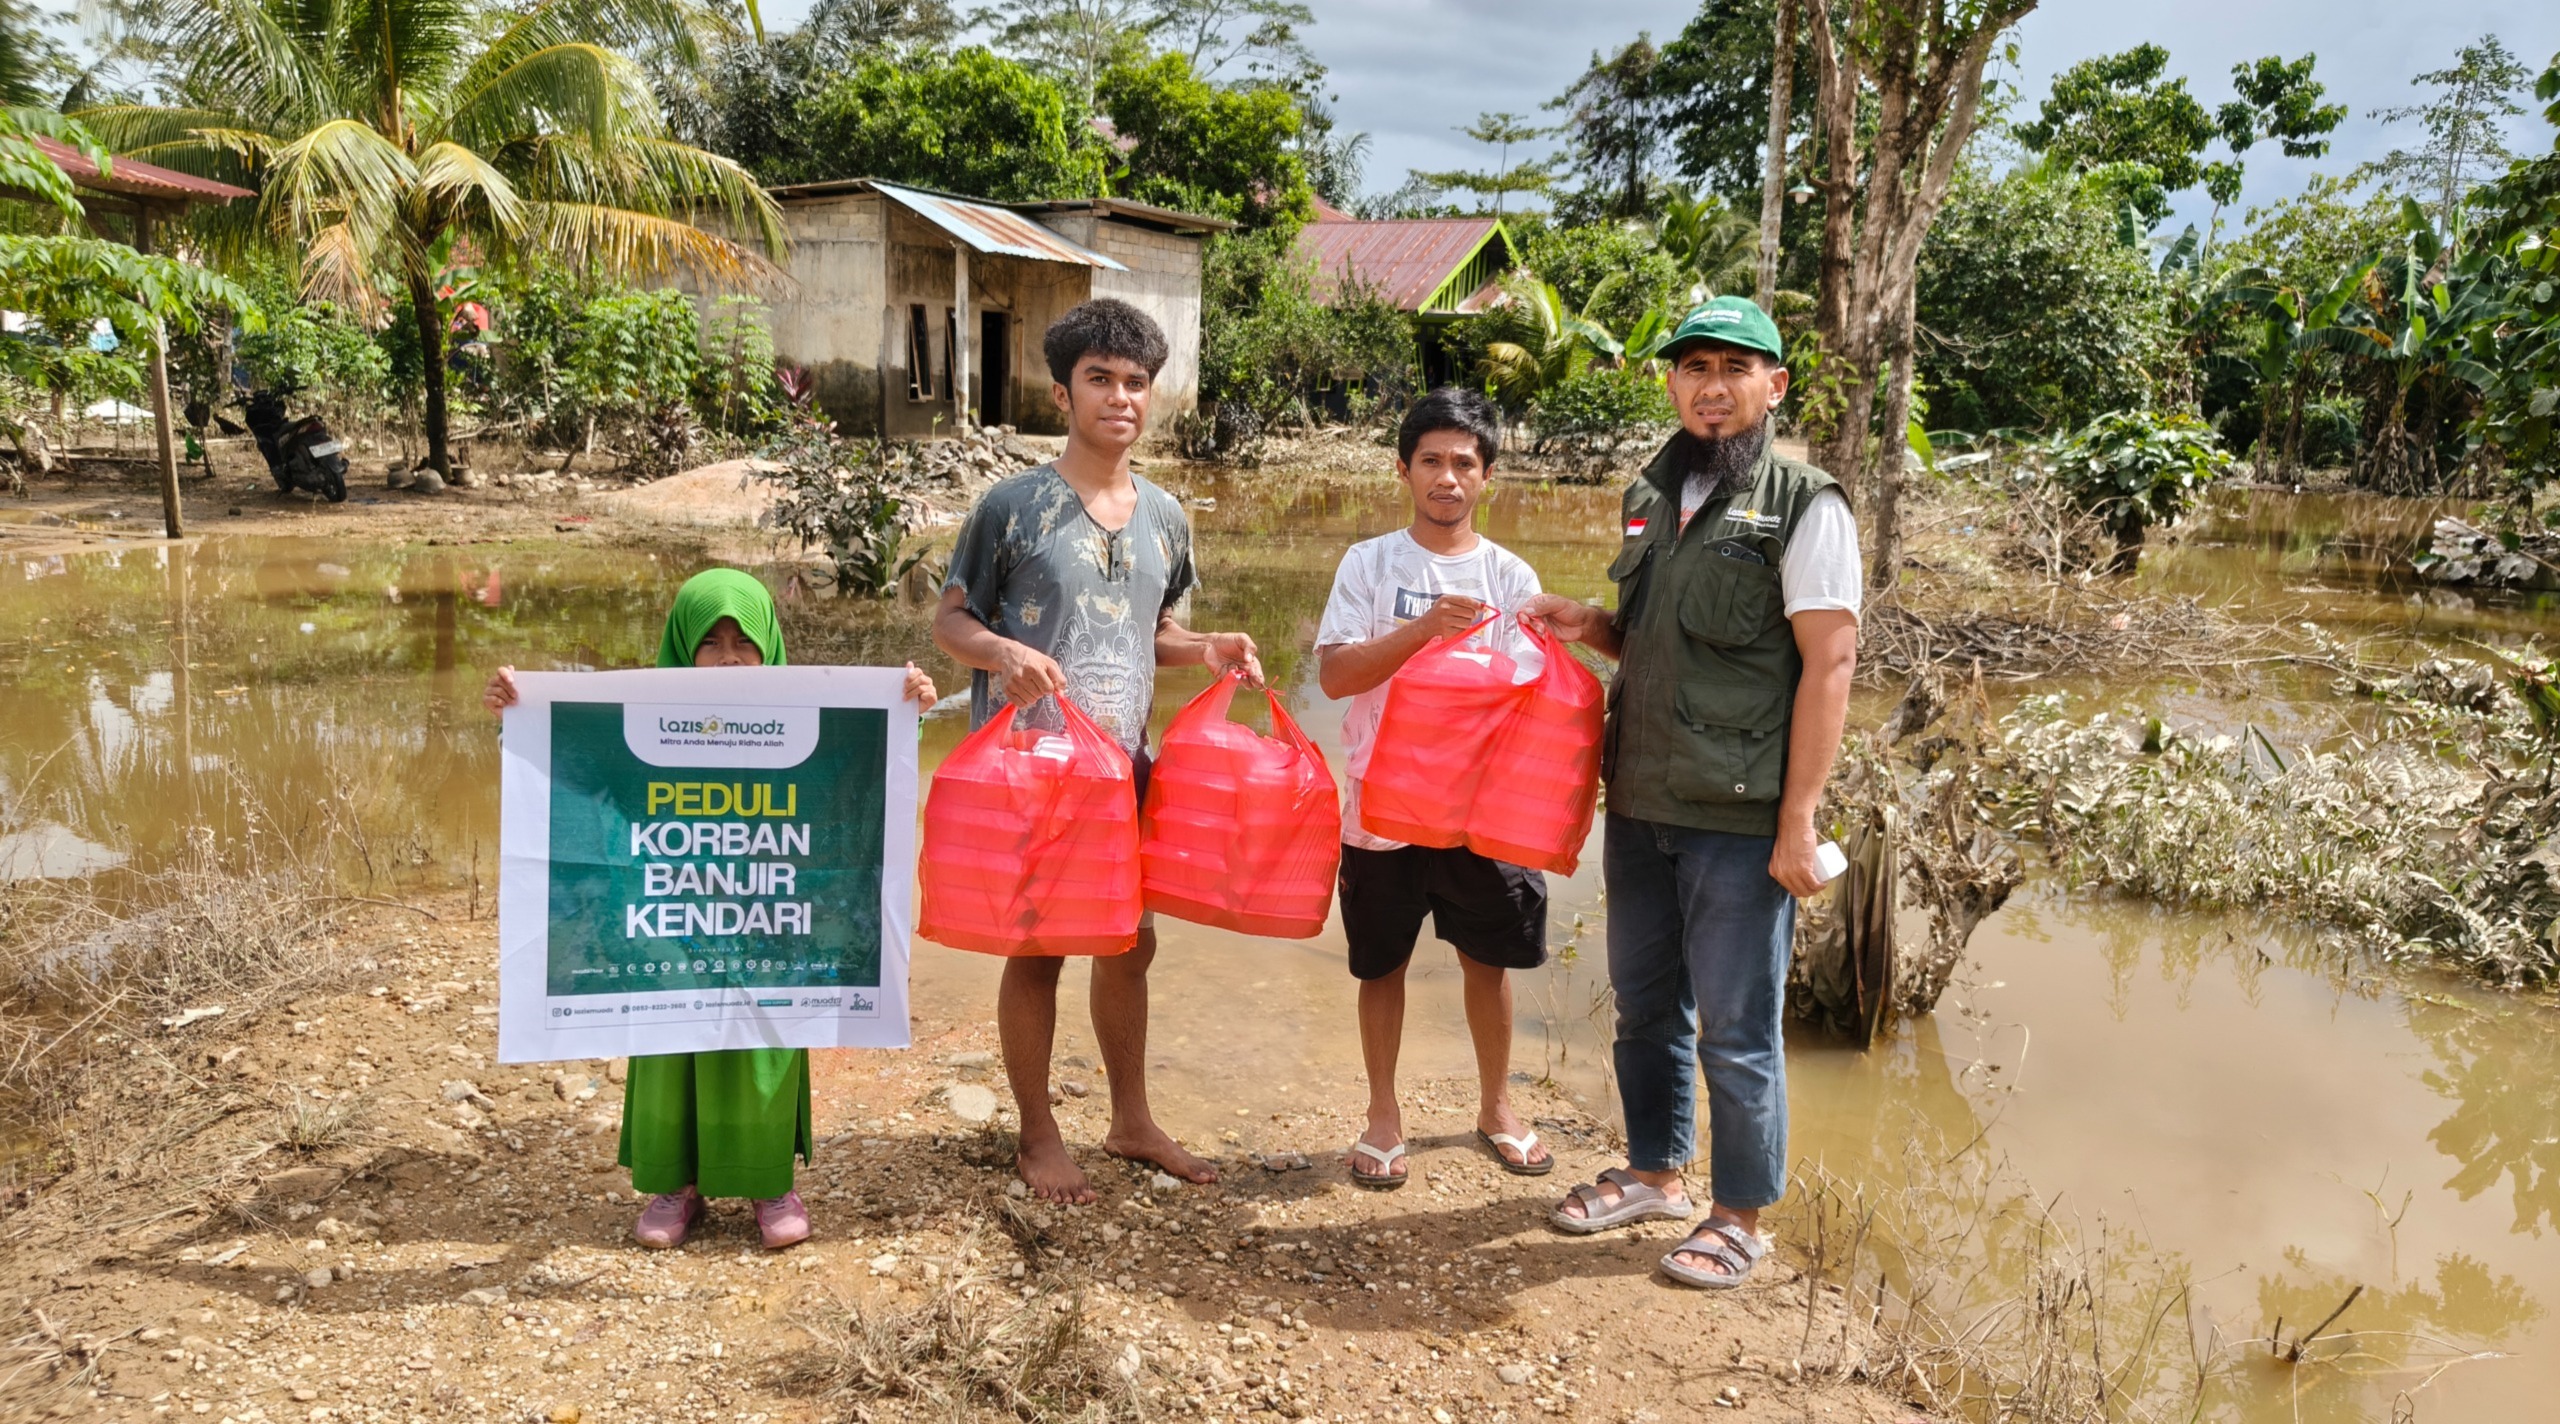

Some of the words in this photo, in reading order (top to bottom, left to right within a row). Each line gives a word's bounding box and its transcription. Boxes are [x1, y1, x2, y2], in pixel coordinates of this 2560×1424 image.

[683, 738, 705, 746] Anda
[707, 738, 737, 748] Menuju
[738, 739, 761, 747] Ridha
[724, 719, 785, 735] muadz
[647, 782, 796, 817] PEDULI
[630, 821, 810, 857] KORBAN
[644, 862, 796, 897] BANJIR
[626, 902, 811, 939] KENDARI
